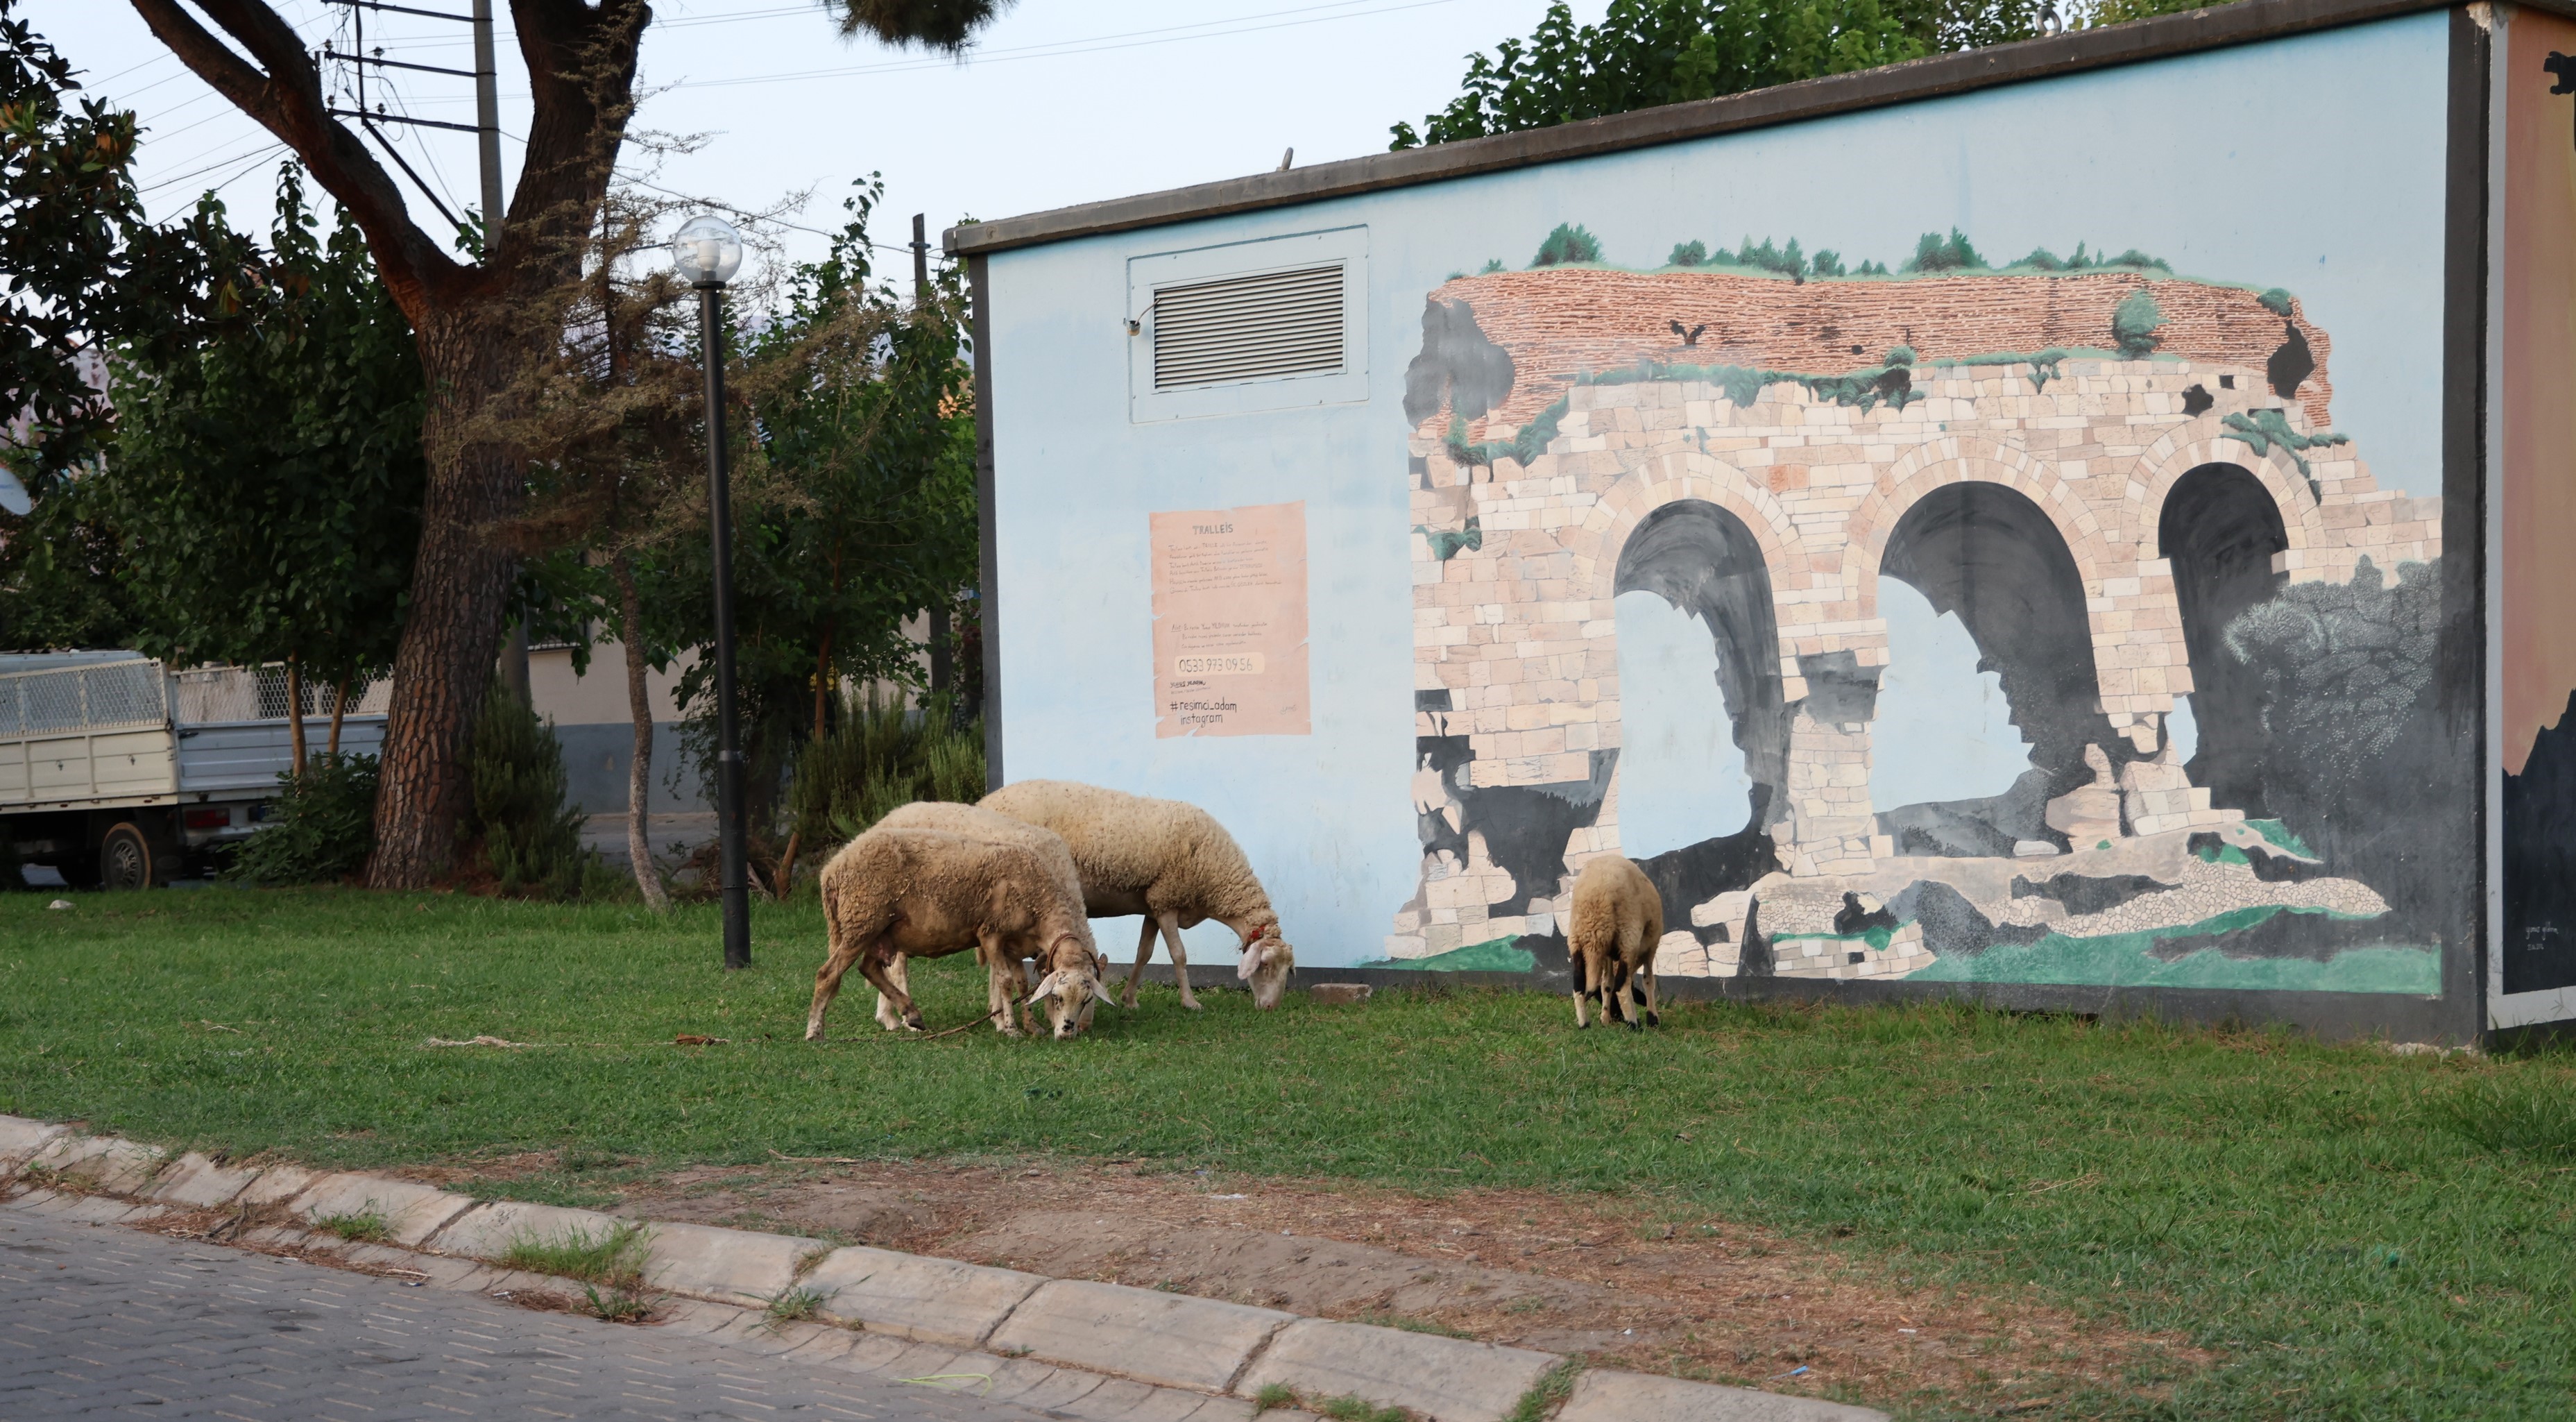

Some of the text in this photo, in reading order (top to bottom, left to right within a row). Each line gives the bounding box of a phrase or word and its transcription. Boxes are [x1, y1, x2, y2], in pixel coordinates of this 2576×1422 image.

[1179, 658, 1253, 672] 0533 973 09 56
[1181, 713, 1223, 728] instagram
